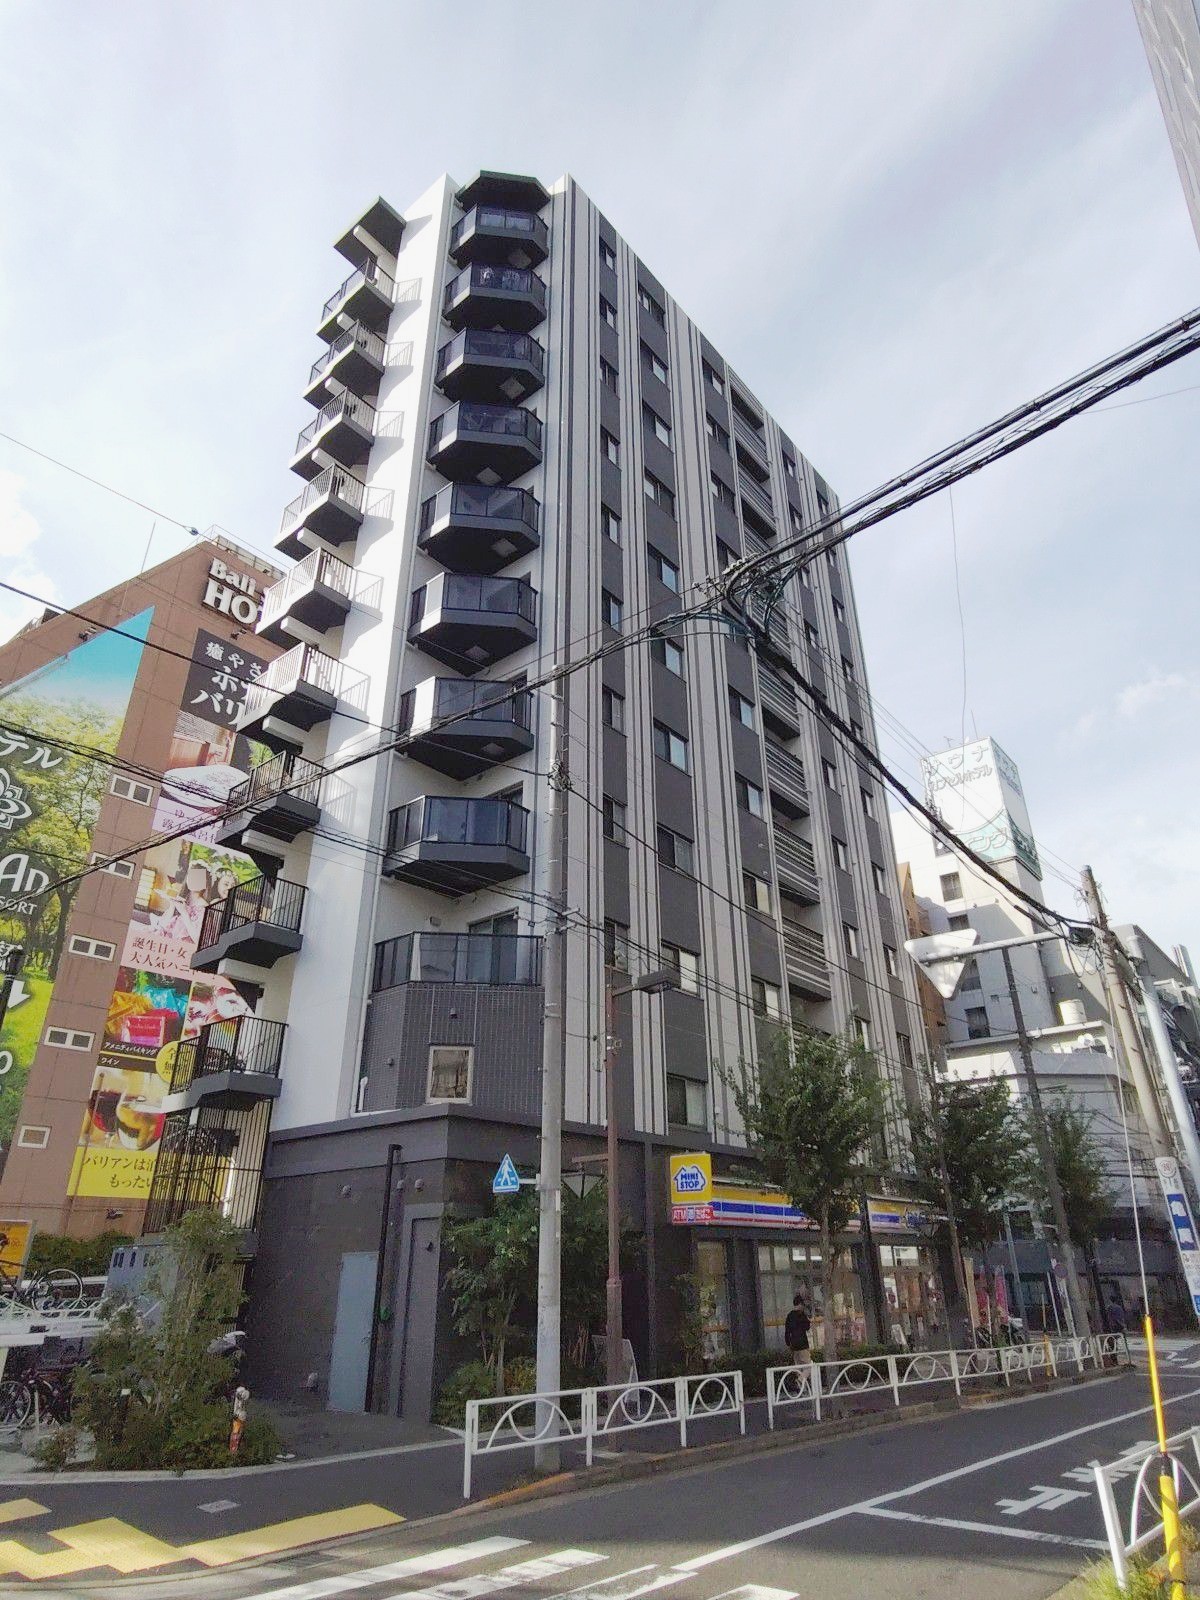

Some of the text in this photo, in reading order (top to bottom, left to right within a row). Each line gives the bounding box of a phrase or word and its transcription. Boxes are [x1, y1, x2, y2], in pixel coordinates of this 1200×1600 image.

[209, 557, 256, 596] Bali
[203, 578, 263, 624] HO
[130, 951, 195, 976] 大人気ハニ
[101, 1057, 120, 1065] ワイン
[680, 1172, 699, 1181] MINI
[680, 1180, 700, 1190] STOP
